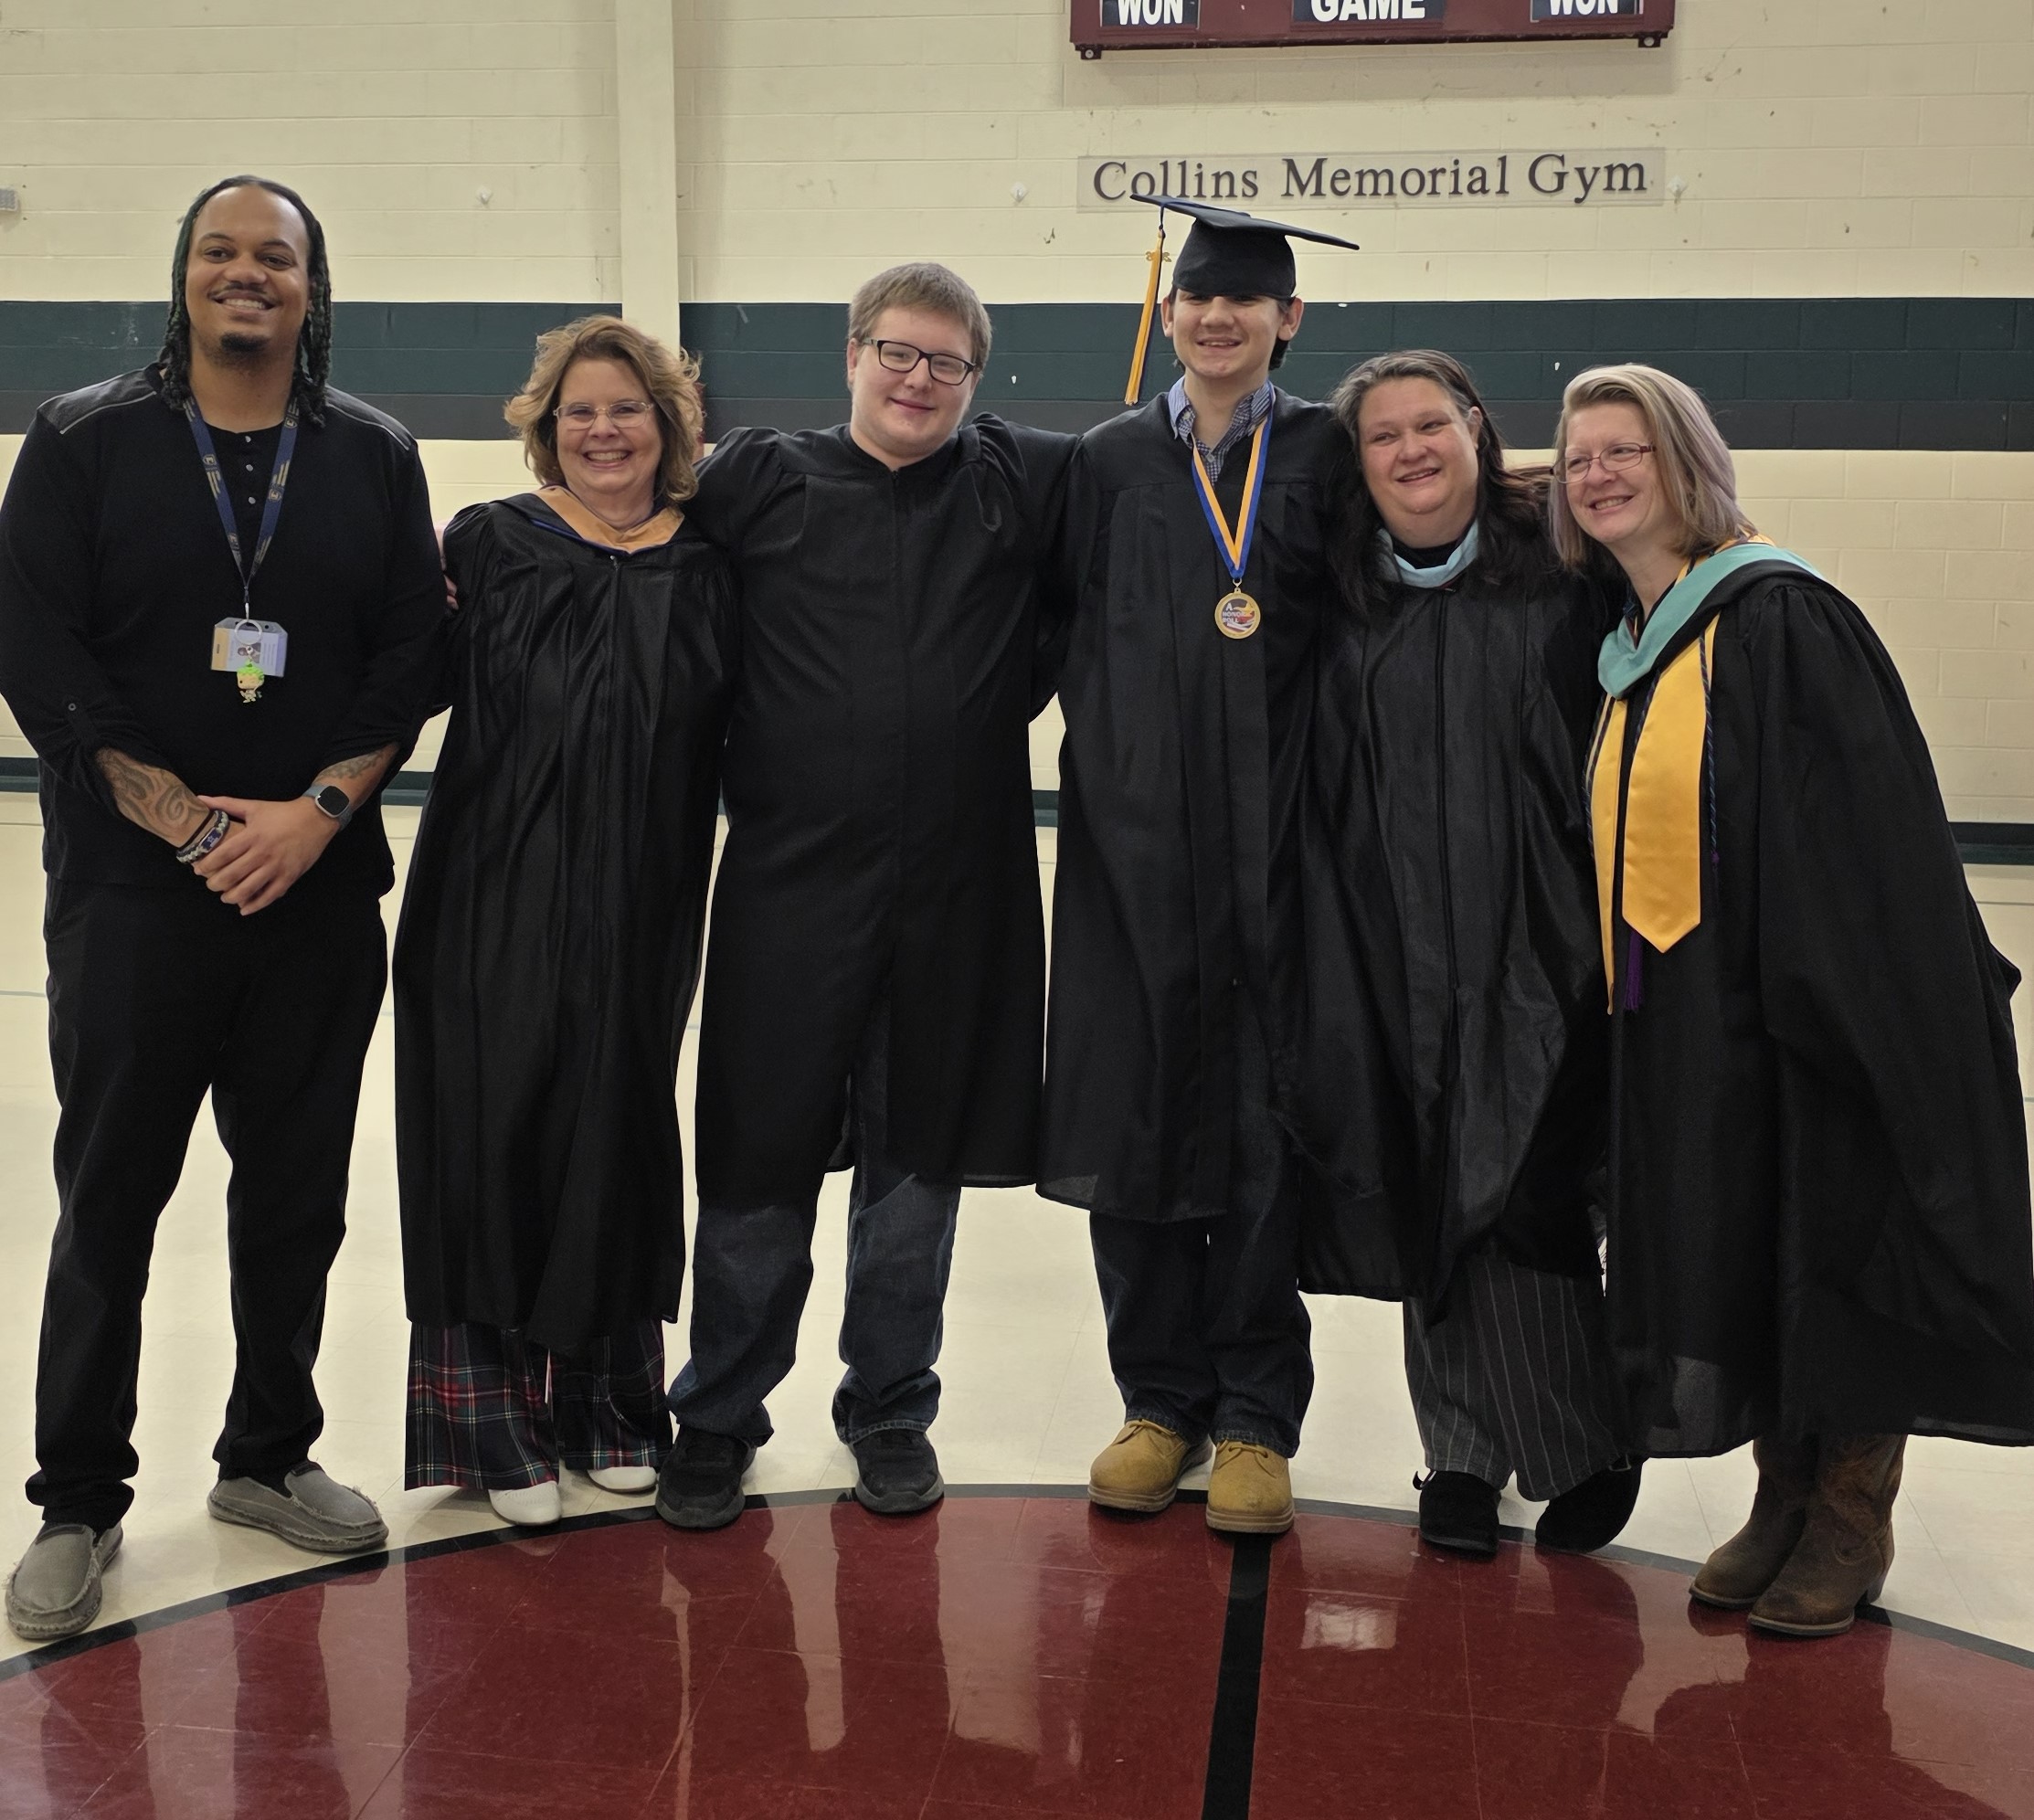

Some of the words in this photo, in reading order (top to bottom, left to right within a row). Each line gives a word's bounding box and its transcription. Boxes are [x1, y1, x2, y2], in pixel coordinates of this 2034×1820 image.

[1094, 160, 1259, 201] Collins
[1281, 155, 1510, 196] Memorial
[1528, 153, 1647, 204] Gym
